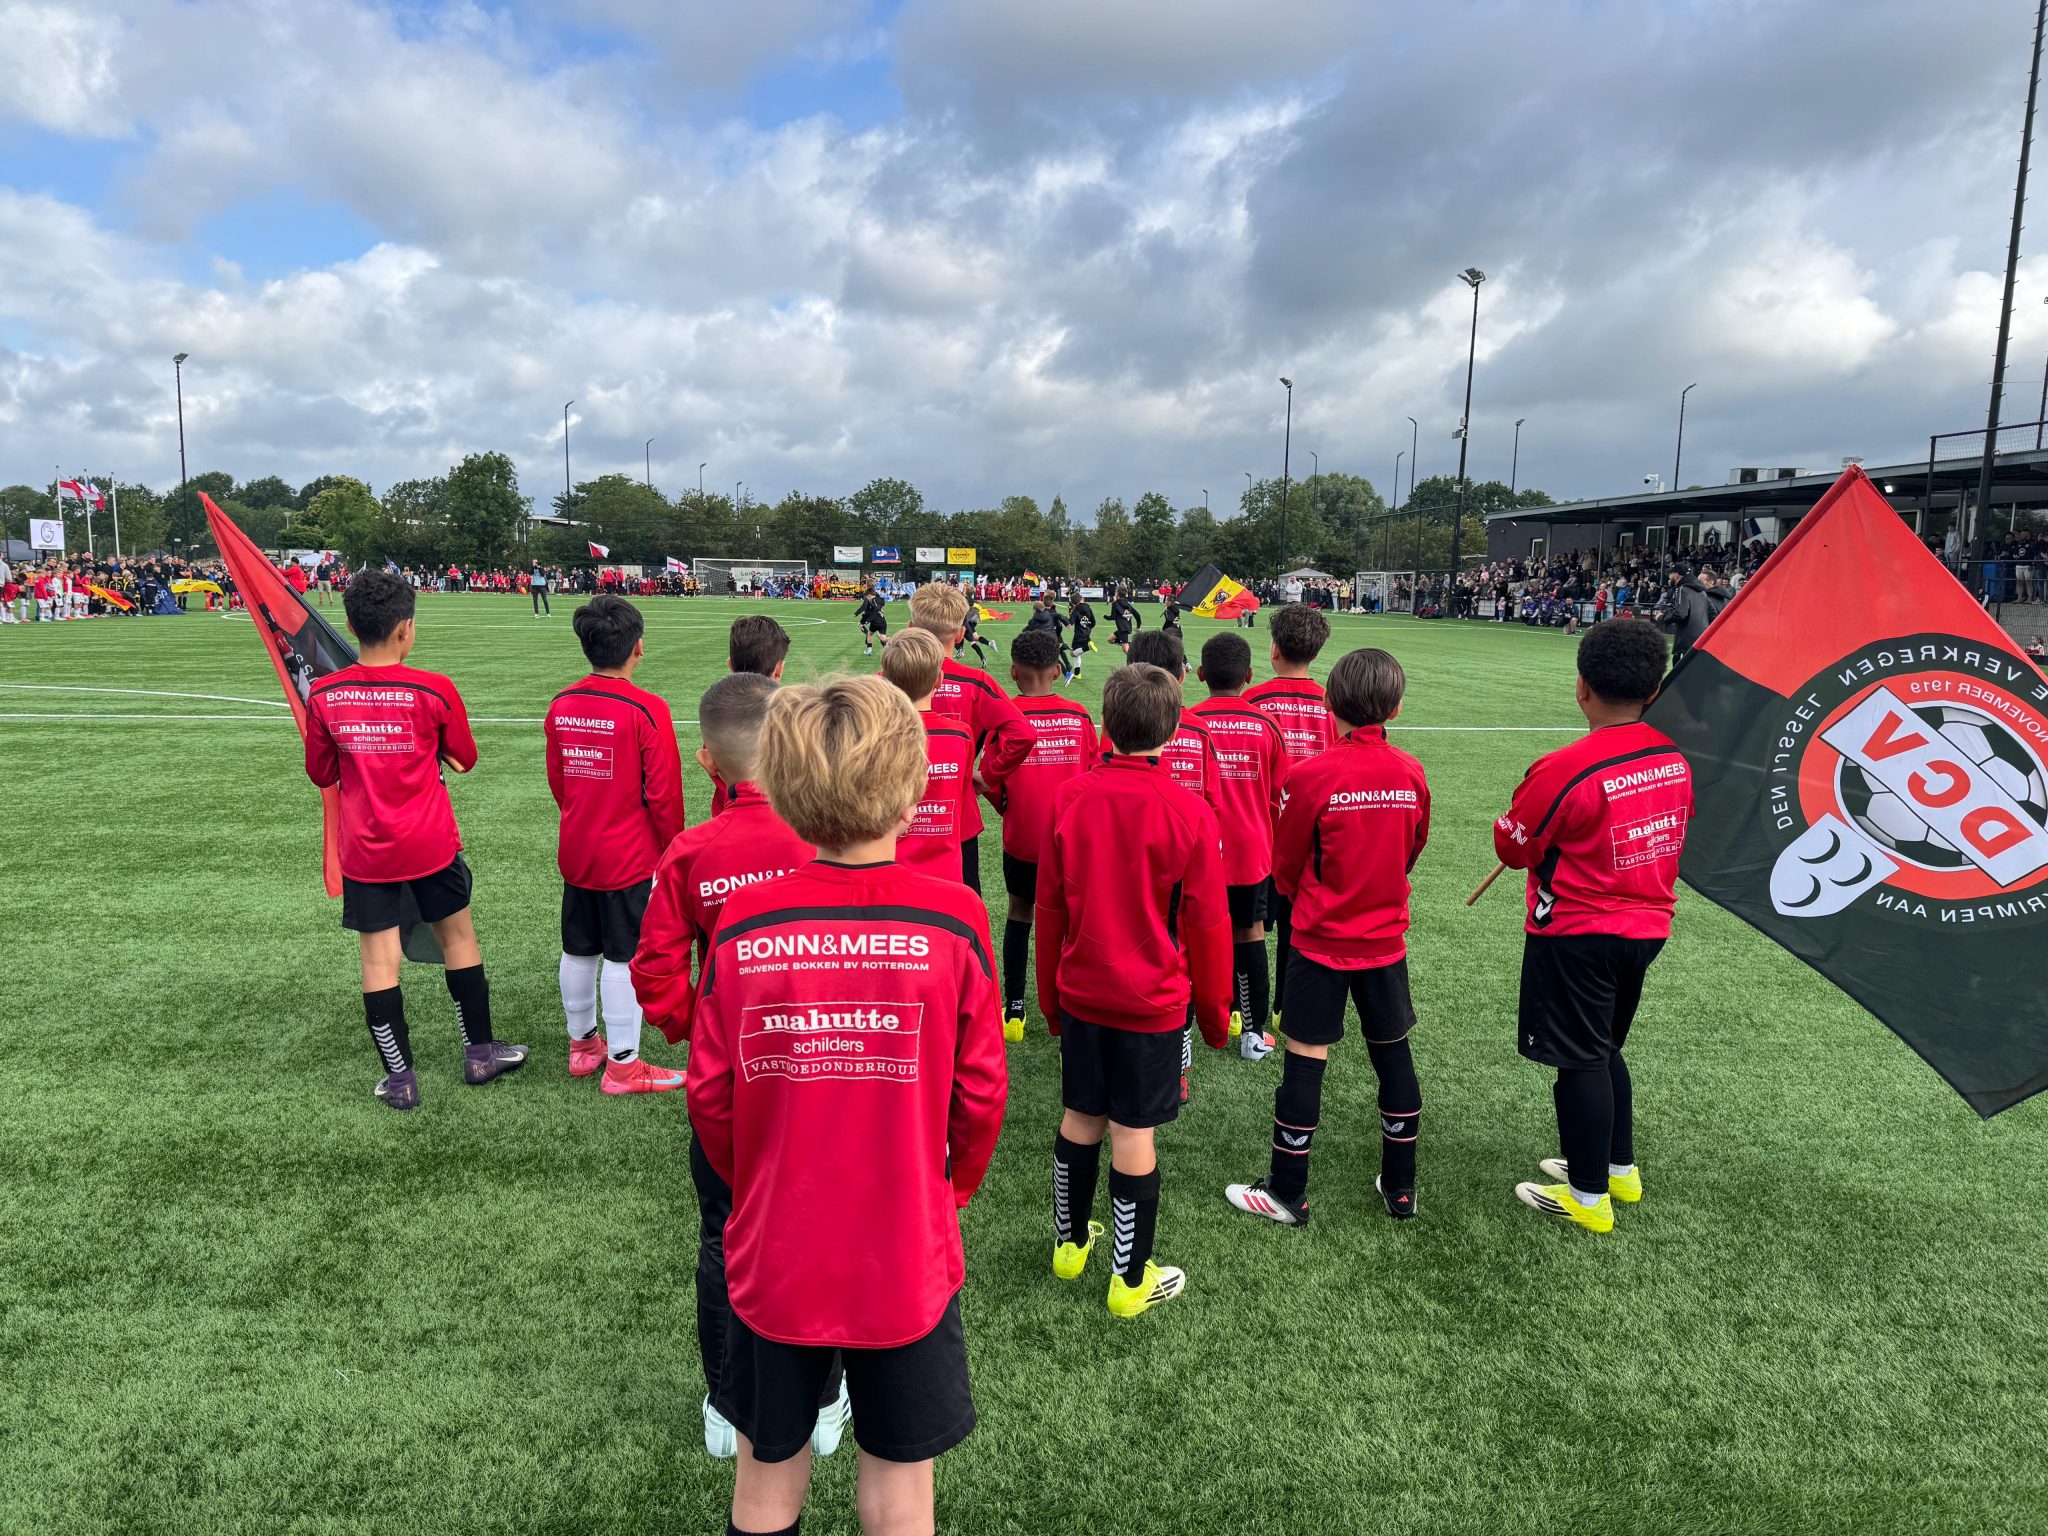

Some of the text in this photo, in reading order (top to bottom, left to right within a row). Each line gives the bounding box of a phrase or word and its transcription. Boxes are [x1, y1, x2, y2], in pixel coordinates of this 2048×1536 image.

[326, 690, 415, 702] BONN&MEES
[1259, 702, 1328, 715] BONN&MEES
[339, 722, 403, 733] mahutte
[1029, 717, 1081, 727] NN&MEES
[1283, 730, 1317, 740] hutte
[1033, 737, 1076, 747] ahutte
[1216, 751, 1250, 761] hutte
[1603, 762, 1687, 794] BONN&MEES
[1329, 790, 1417, 805] BONN&MEES
[915, 803, 947, 813] utte
[699, 868, 796, 898] BONN&
[702, 897, 728, 907] DRIJVE
[736, 933, 930, 961] BONN&MEES
[738, 961, 930, 976] DRIJVENDE BOKKEN BV ROTTERDAM
[761, 1008, 900, 1031] mahutte
[793, 1036, 865, 1054] schilders
[751, 1059, 917, 1076] VASTGOEDONDERHOUD
